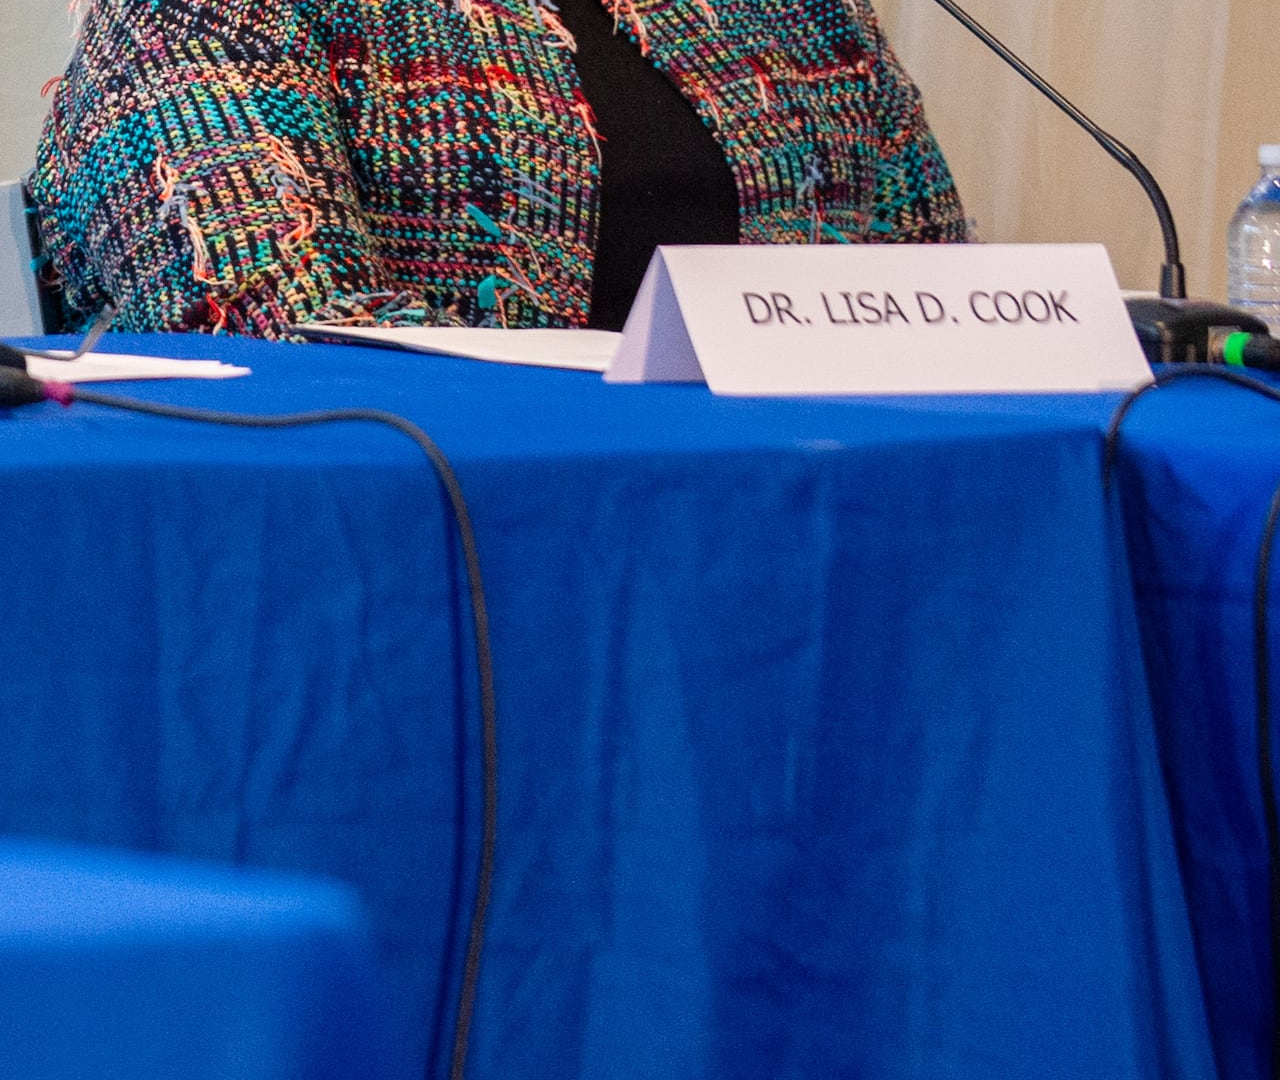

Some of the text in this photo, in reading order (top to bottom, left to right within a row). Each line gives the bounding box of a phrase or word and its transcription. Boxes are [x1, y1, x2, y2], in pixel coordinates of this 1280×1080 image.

[742, 290, 1080, 325] DR. LISA D. COOK
